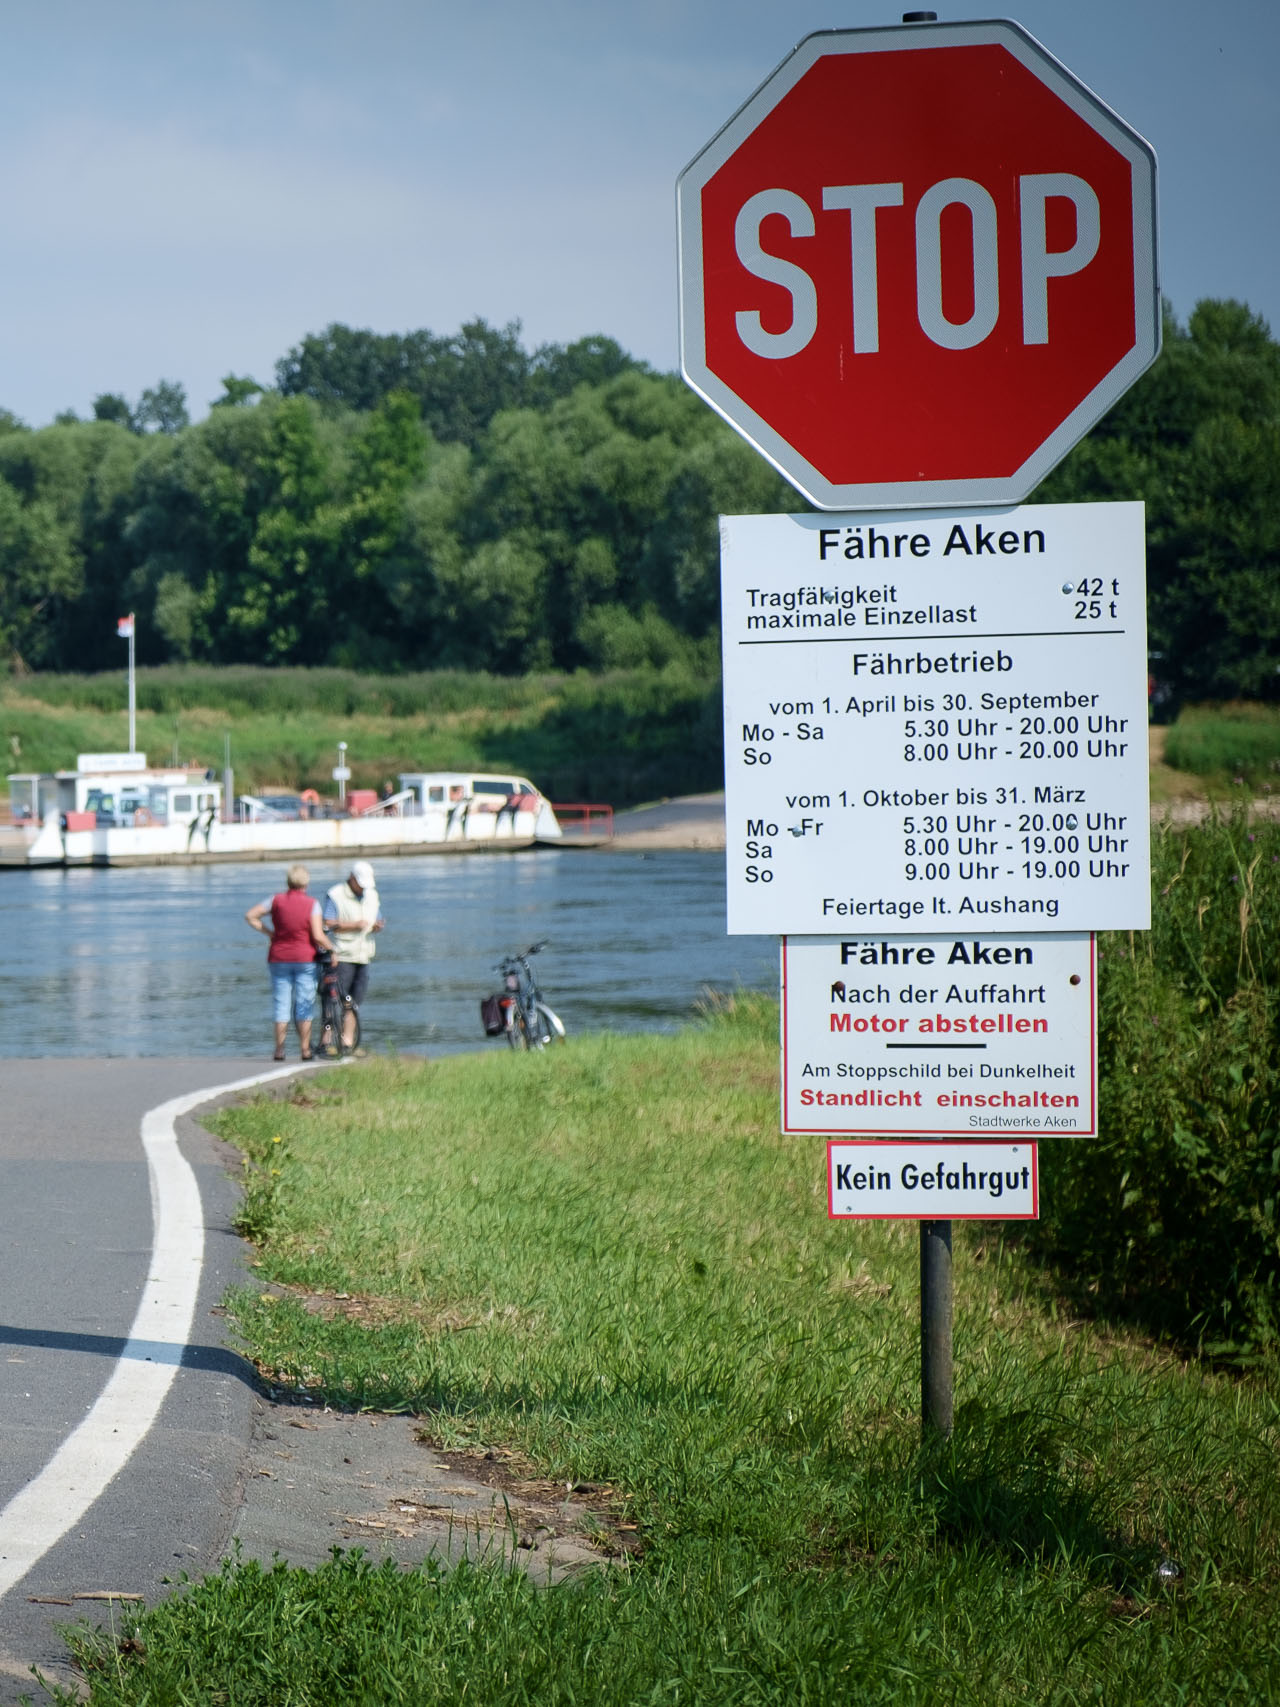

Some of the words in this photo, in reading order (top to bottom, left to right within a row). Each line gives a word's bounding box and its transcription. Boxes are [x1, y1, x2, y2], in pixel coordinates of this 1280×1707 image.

[734, 172, 1101, 360] STOP
[819, 526, 931, 561] Fähre
[942, 523, 1046, 556] Aken
[746, 584, 898, 609] Tragfähigkeit
[1076, 578, 1104, 597] 42
[1111, 578, 1120, 596] t
[746, 608, 857, 629] maximale
[864, 604, 978, 626] Einzellast
[1074, 601, 1102, 620] 25
[1108, 600, 1118, 619] t
[853, 650, 1013, 676] Fährbetrieb
[769, 701, 814, 716] vom
[822, 697, 839, 714] 1.
[845, 695, 896, 718] April
[903, 695, 935, 713] bis
[942, 694, 973, 711] 30.
[980, 691, 1100, 712] September
[742, 723, 775, 742] Mo
[796, 722, 824, 741] Sa
[904, 719, 949, 738] 5.30
[957, 718, 998, 737] Uhr
[1019, 716, 1079, 735] 20.00
[1087, 715, 1129, 734] Uhr
[743, 747, 772, 767] So
[904, 743, 949, 762] 8.00
[957, 742, 998, 761] Uhr
[1019, 740, 1079, 760] 20.00
[1087, 739, 1129, 758] Uhr
[785, 795, 830, 809] vom
[838, 790, 856, 808] 1.
[863, 788, 950, 807] Oktober
[956, 787, 988, 806] bis
[995, 787, 1026, 805] 31.
[1034, 786, 1086, 804] März
[747, 819, 779, 837] Mo
[801, 818, 824, 836] Fr
[903, 815, 948, 835] 5.30
[956, 814, 997, 834] Uhr
[1086, 812, 1128, 831] Uhr
[745, 840, 773, 859] Sa
[904, 837, 950, 857] 8.00
[958, 836, 999, 856] Uhr
[1021, 835, 1080, 855] 19.00
[1088, 834, 1129, 853] Uhr
[745, 865, 774, 883] So
[905, 862, 950, 881] 9.00
[959, 861, 1000, 880] Uhr
[1022, 860, 1081, 879] 19.00
[1089, 859, 1130, 878] Uhr
[823, 899, 925, 920] Feiertage
[932, 896, 952, 915] lt.
[959, 895, 1059, 918] Aushang
[840, 941, 936, 966] Fähre
[947, 940, 1033, 965] Aken
[831, 984, 890, 1003] Nach
[899, 984, 939, 1004] der
[945, 983, 1046, 1004] Auffahrt
[830, 1013, 910, 1033] Motor
[918, 1013, 1048, 1033] abstellen
[801, 1063, 830, 1078] Am
[836, 1063, 941, 1081] Stoppschild
[947, 1063, 974, 1078] bei
[980, 1064, 1076, 1079] Dunkelheit
[800, 1088, 922, 1107] Standlicht
[936, 1090, 1080, 1108] einschalten
[969, 1115, 1041, 1127] Stadtwerke
[1044, 1115, 1077, 1127] Aken
[836, 1164, 891, 1190] Kein
[900, 1161, 1030, 1198] Gefahrgut
